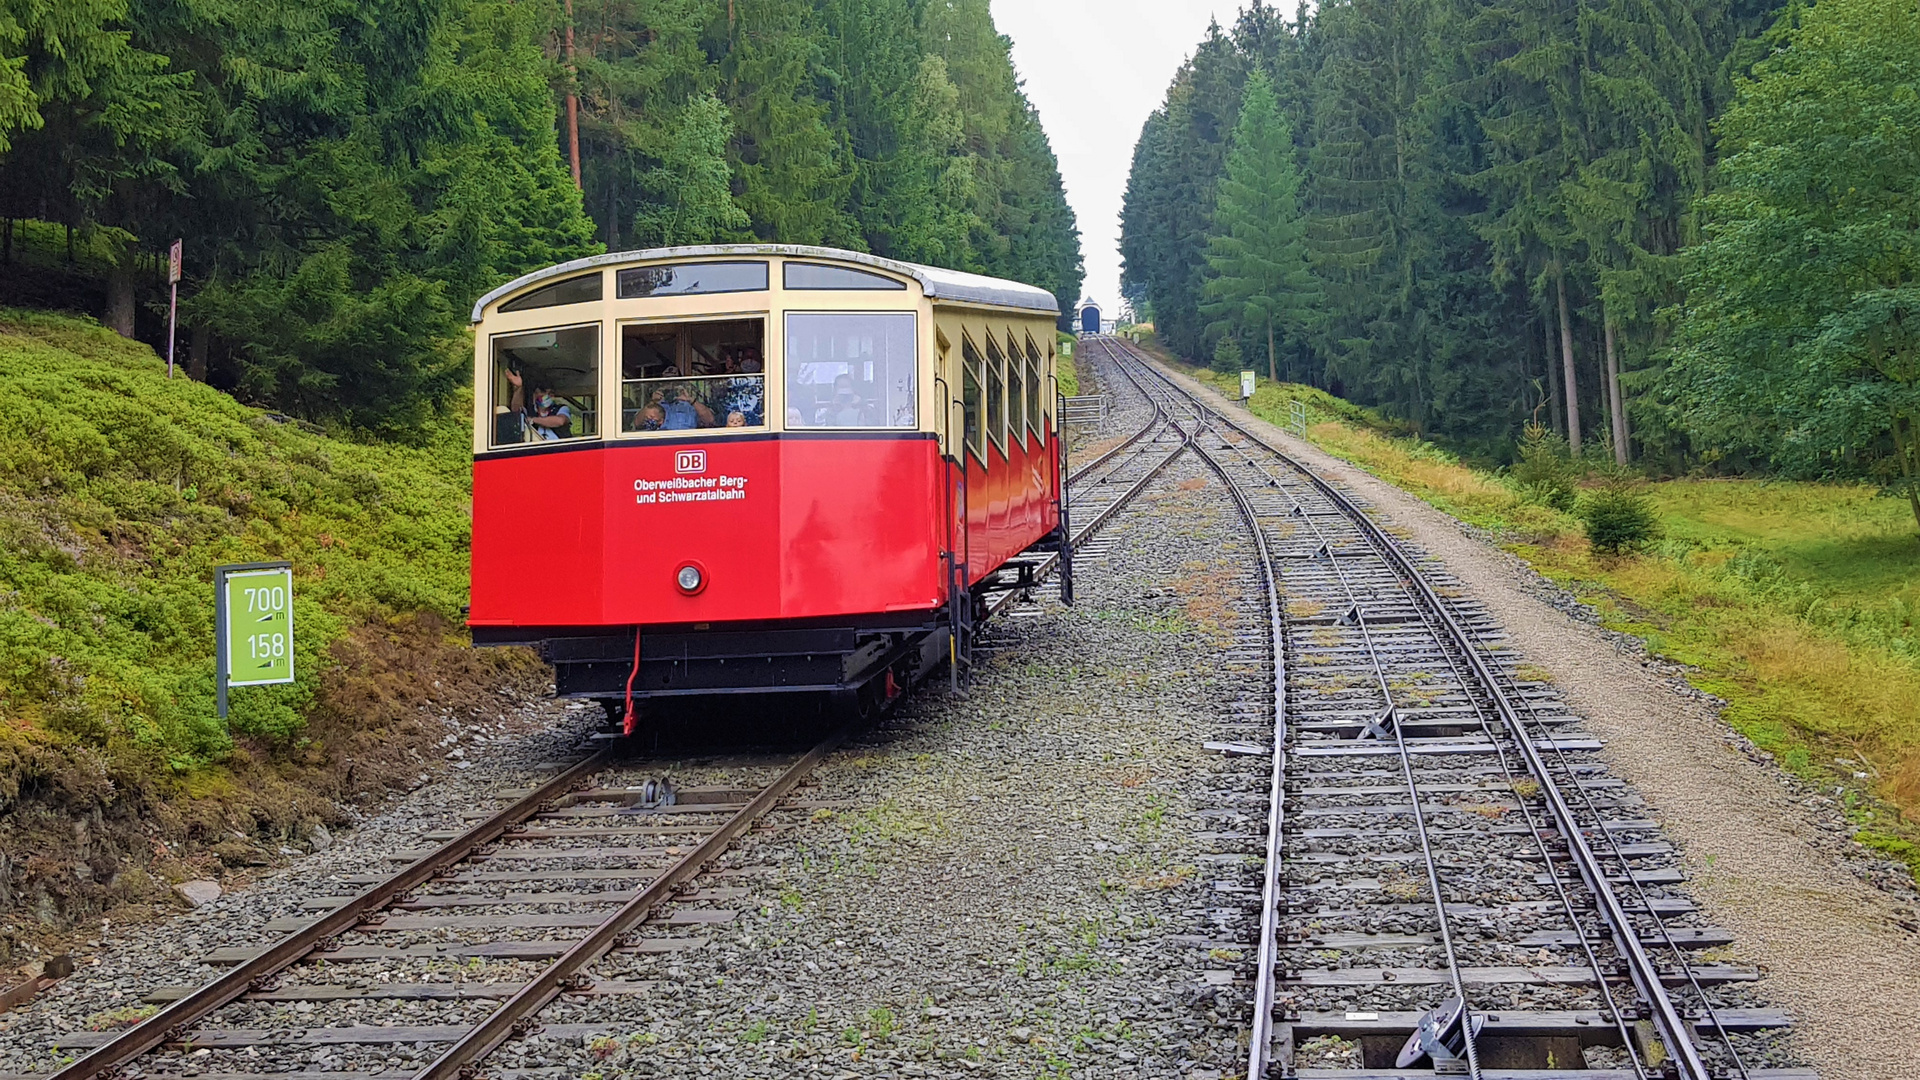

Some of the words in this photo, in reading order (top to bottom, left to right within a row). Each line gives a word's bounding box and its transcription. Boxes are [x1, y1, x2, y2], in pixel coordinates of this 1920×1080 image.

[679, 455, 702, 469] DB
[634, 477, 718, 491] Oberweißbacher
[719, 475, 748, 489] Berg-
[636, 491, 656, 504] und
[658, 489, 745, 503] Schwarzatalbahn
[244, 587, 284, 612] 700
[276, 612, 285, 620] m
[248, 633, 284, 658] 158
